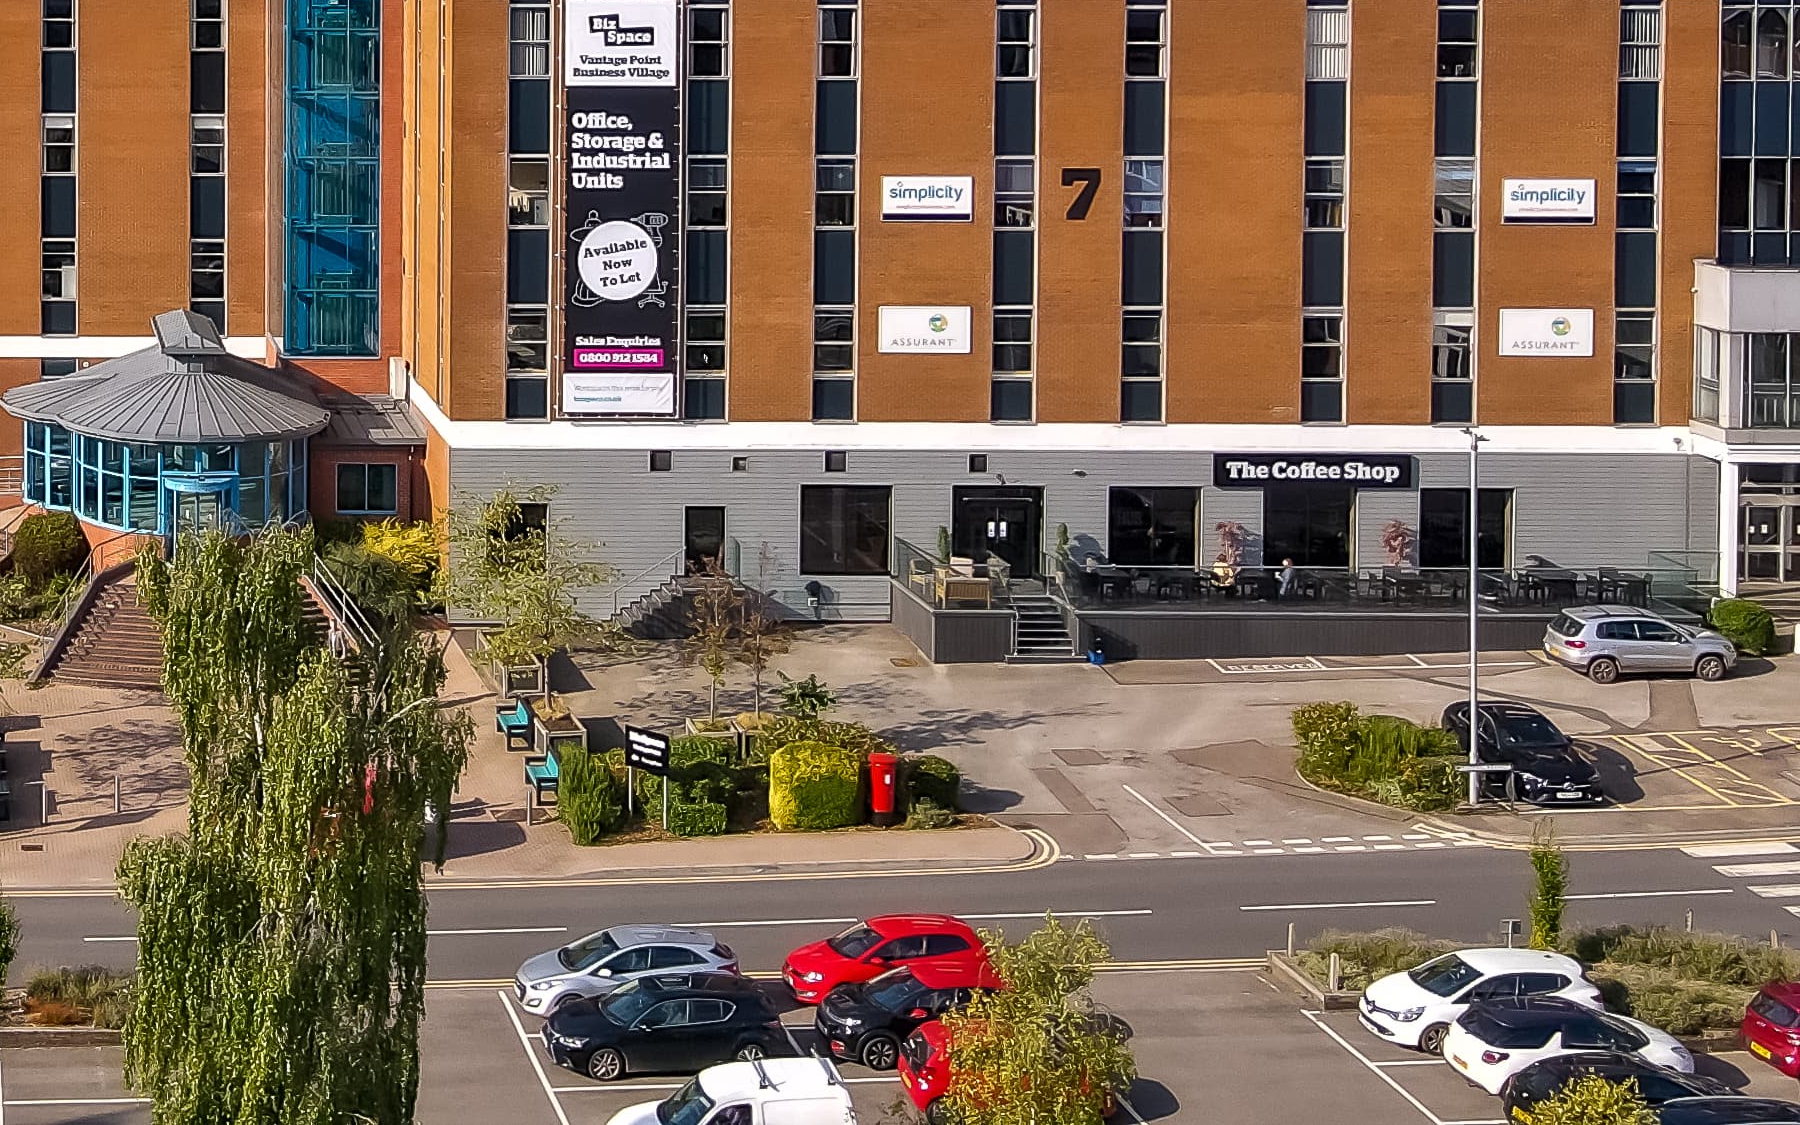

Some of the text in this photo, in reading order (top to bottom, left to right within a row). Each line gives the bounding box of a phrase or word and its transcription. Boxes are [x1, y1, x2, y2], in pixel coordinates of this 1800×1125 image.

[592, 17, 617, 30] Biz
[607, 31, 652, 45] Space
[580, 55, 662, 66] Vantage Point
[572, 67, 670, 79] Business Village
[571, 111, 633, 131] Office,
[571, 132, 664, 152] Storage &
[571, 152, 671, 169] Industrial
[571, 172, 624, 189] Units
[889, 180, 964, 203] simplicity
[1061, 167, 1102, 221] 7
[1510, 183, 1586, 205] simplicity
[583, 239, 648, 259] Available
[602, 258, 633, 270] Now
[599, 271, 642, 287] To Let
[575, 336, 661, 348] Sales Enquiries
[890, 337, 954, 346] ASSURANT
[1511, 340, 1576, 350] ASSURANT
[579, 352, 611, 363] 0800
[1225, 461, 1400, 483] The Coffee Shop
